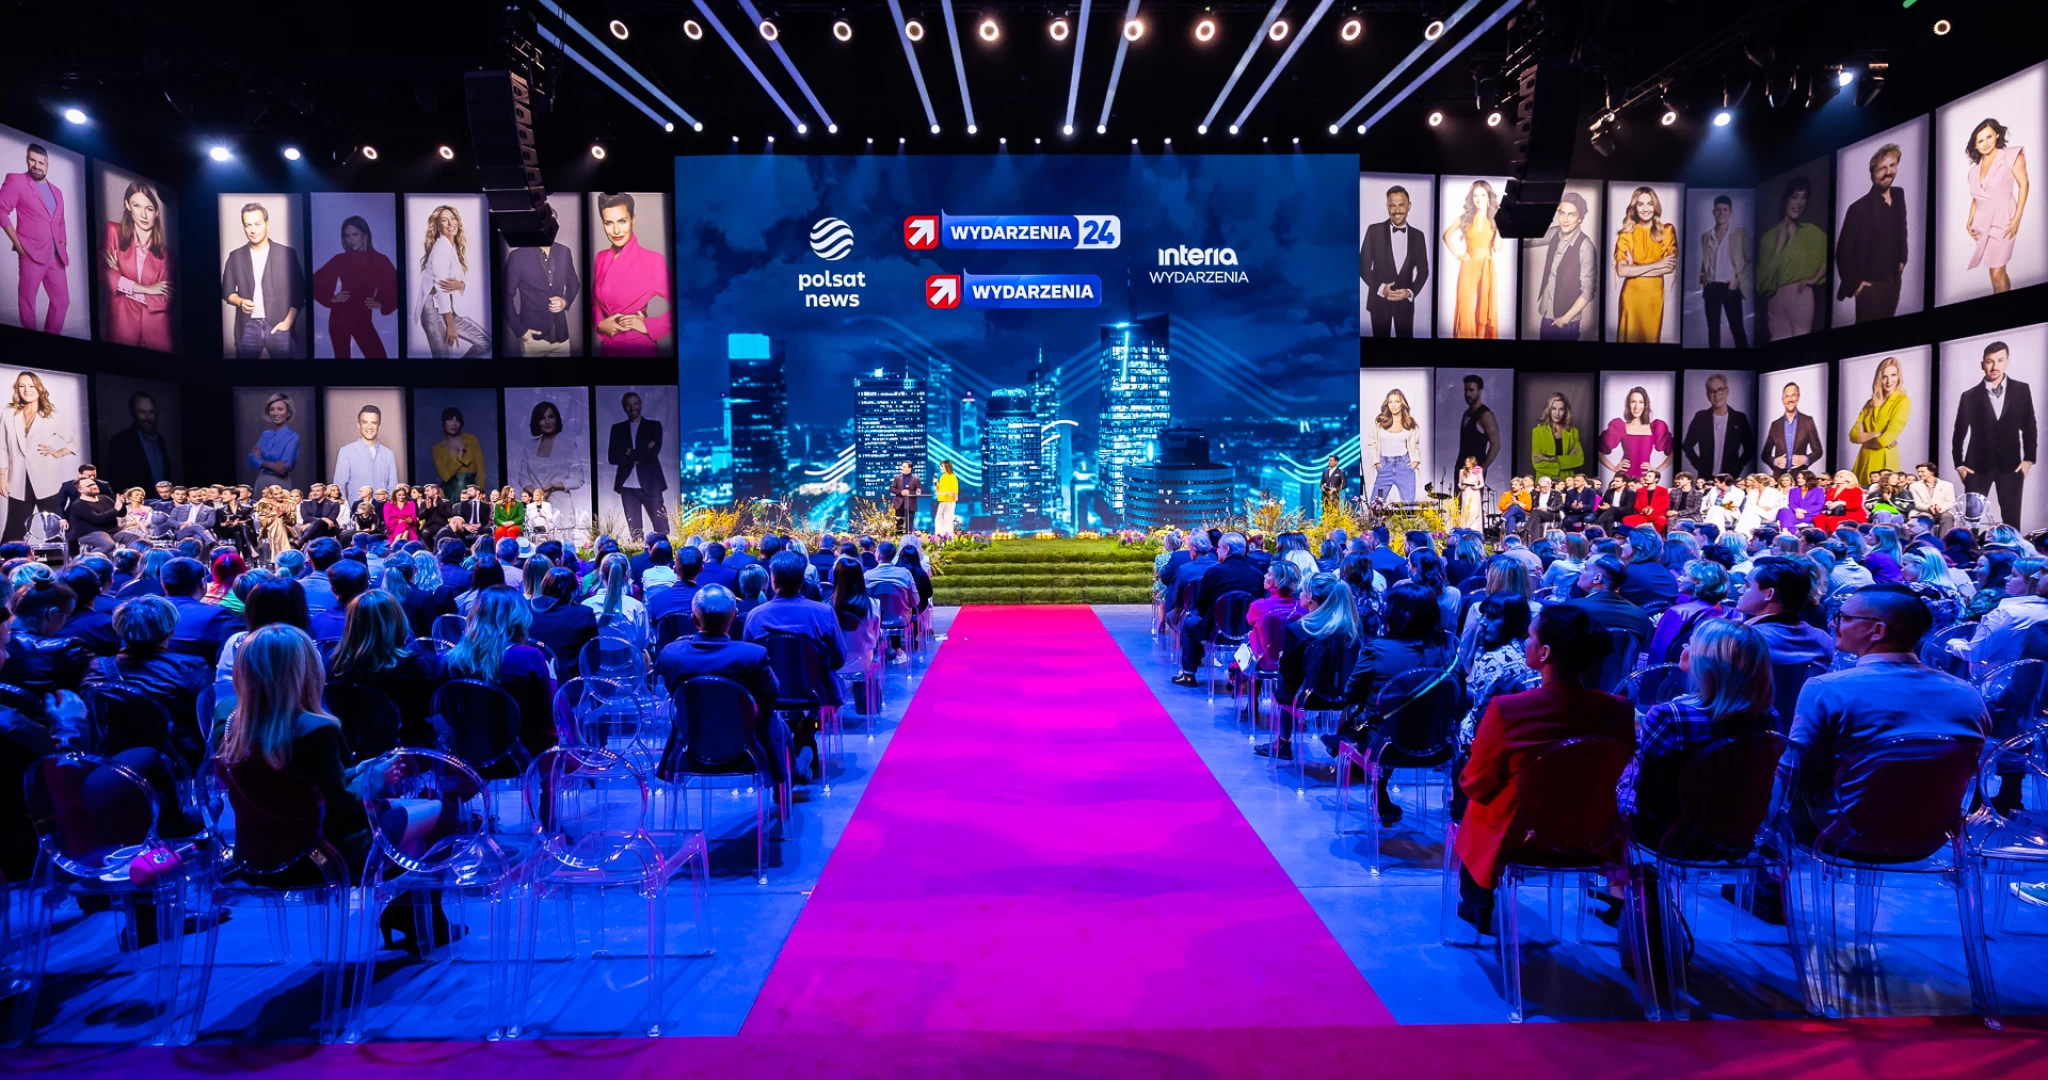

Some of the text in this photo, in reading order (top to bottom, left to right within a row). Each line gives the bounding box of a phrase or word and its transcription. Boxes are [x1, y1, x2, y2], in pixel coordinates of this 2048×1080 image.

[951, 220, 1115, 245] WYDARZENIA 24
[1158, 244, 1239, 266] interia
[798, 270, 866, 291] polsat
[1149, 271, 1249, 284] WYDARZENIA
[805, 293, 860, 307] news
[972, 284, 1094, 299] WYDARZENIA
